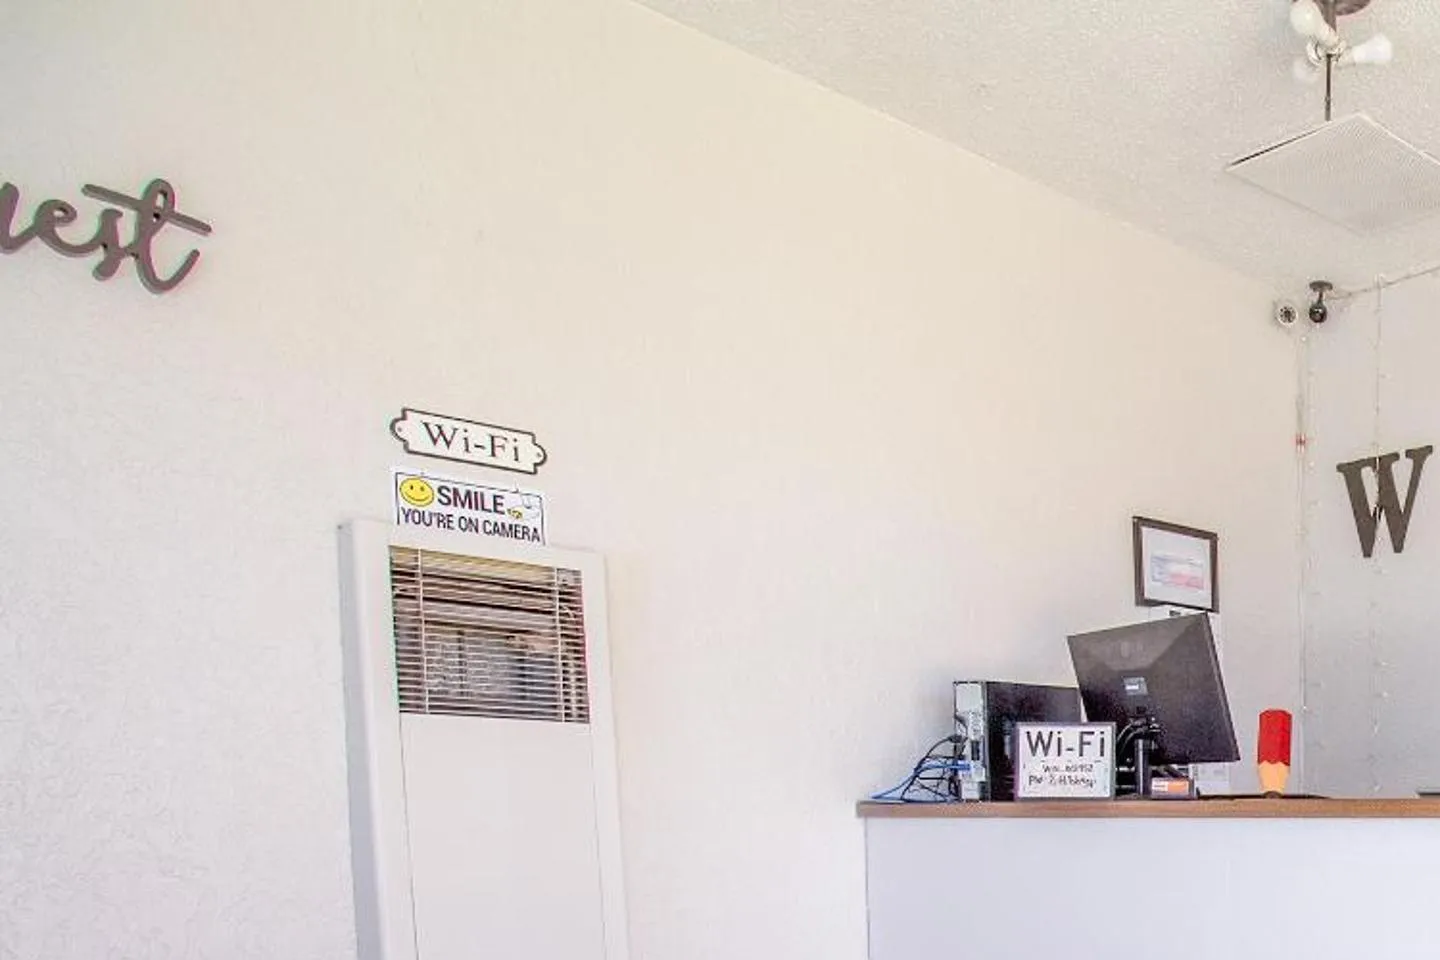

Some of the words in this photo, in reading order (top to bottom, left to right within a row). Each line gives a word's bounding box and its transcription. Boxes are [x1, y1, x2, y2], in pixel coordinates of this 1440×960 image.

[422, 421, 519, 462] Wi-Fi
[437, 485, 506, 515] SMILE
[401, 507, 454, 530] YOU'RE
[458, 516, 479, 534] ON
[483, 520, 541, 543] CAMERA
[1026, 730, 1105, 757] Wi-Fi
